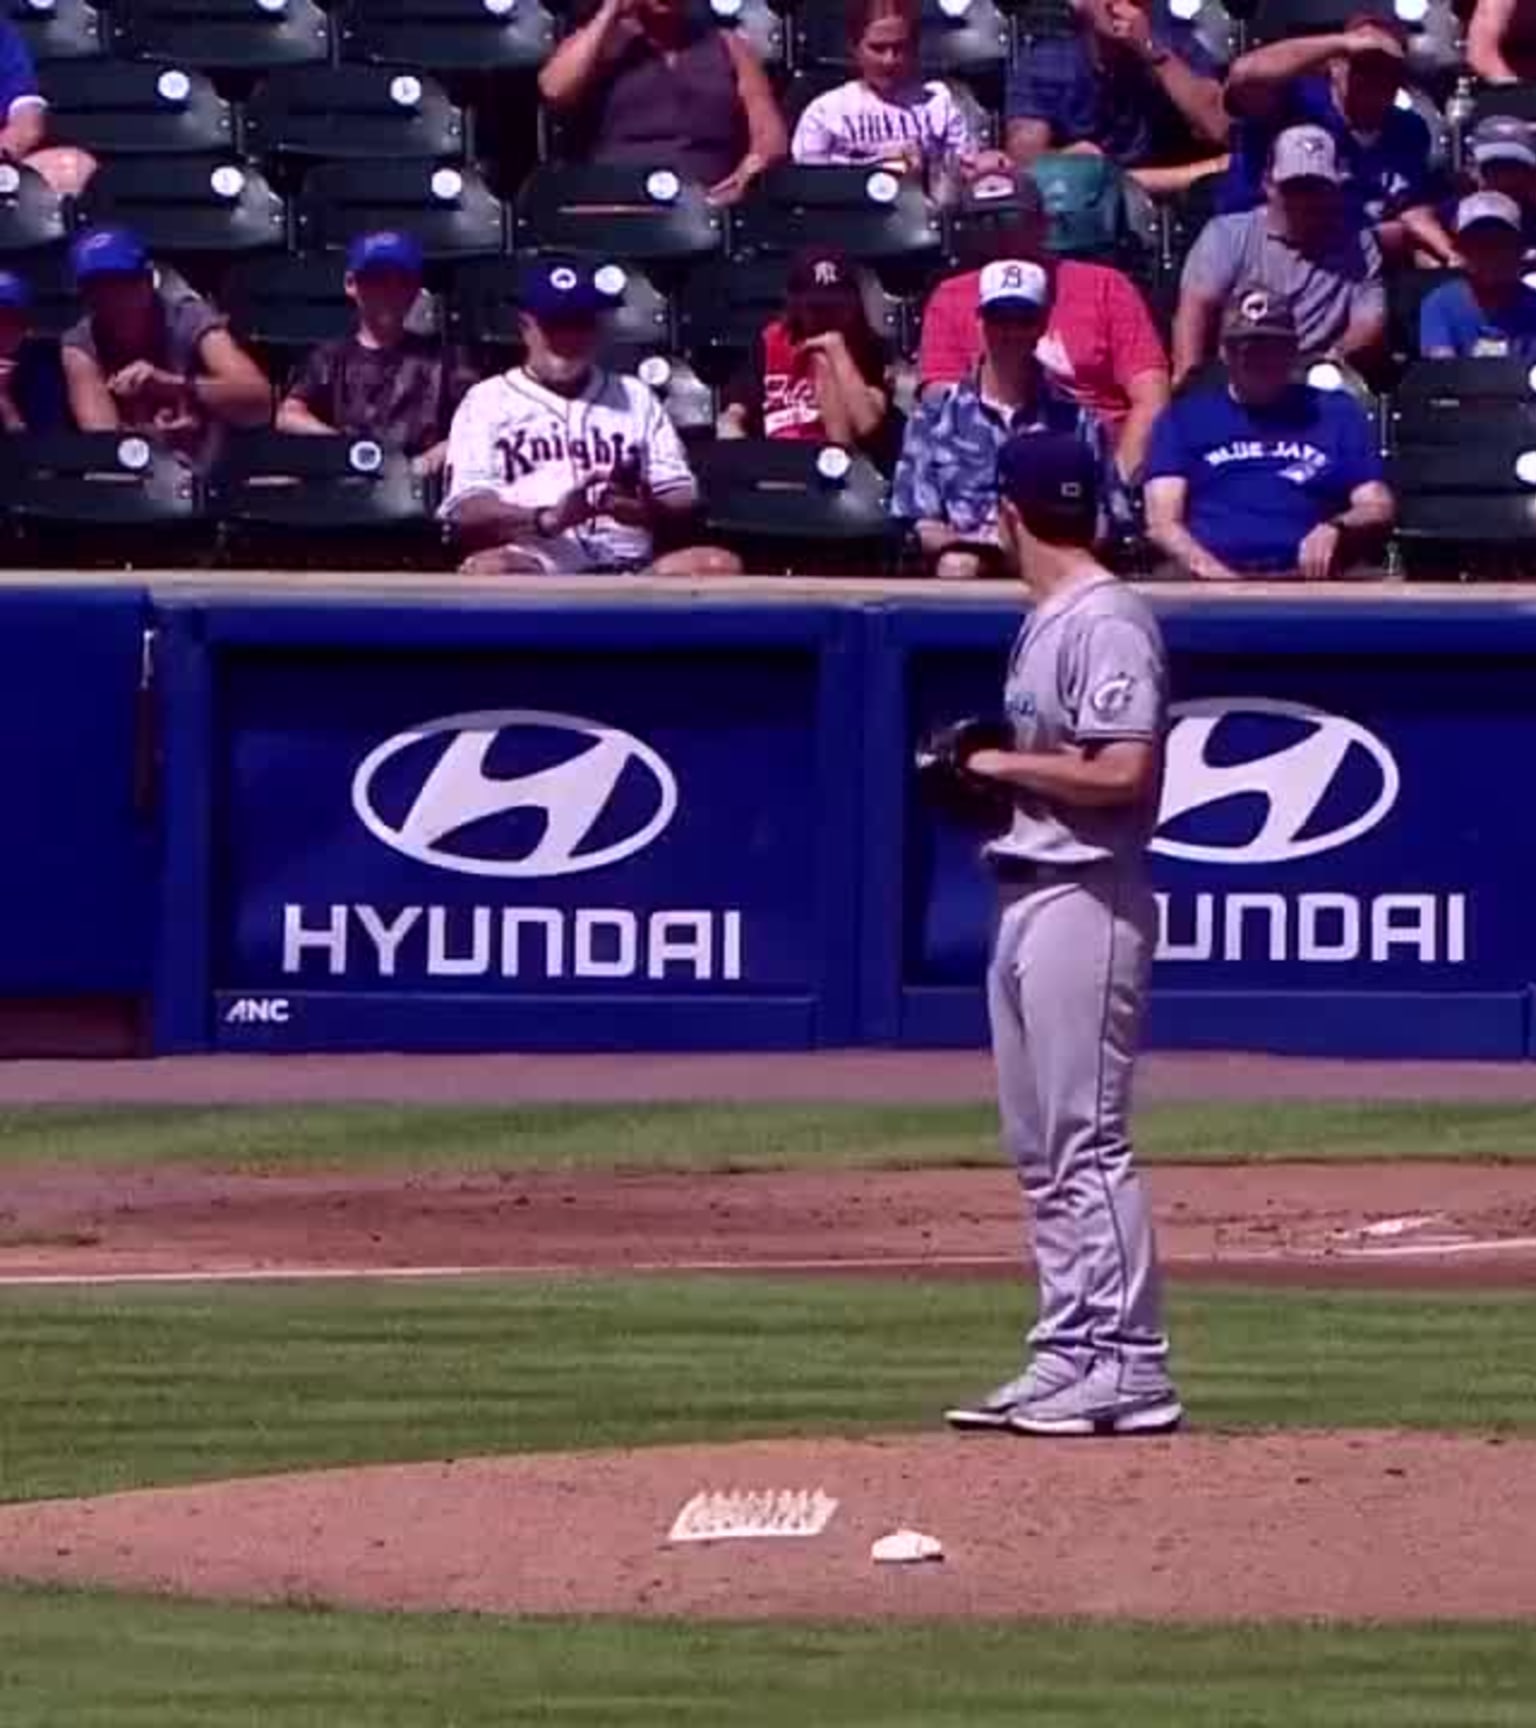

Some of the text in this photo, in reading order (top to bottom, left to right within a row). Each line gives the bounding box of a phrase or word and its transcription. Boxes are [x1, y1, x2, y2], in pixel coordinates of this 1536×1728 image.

[1204, 441, 1264, 466] BLUE
[283, 903, 740, 979] HYUNDAI
[1153, 893, 1466, 962] UNDAI
[226, 1000, 289, 1022] ANC
